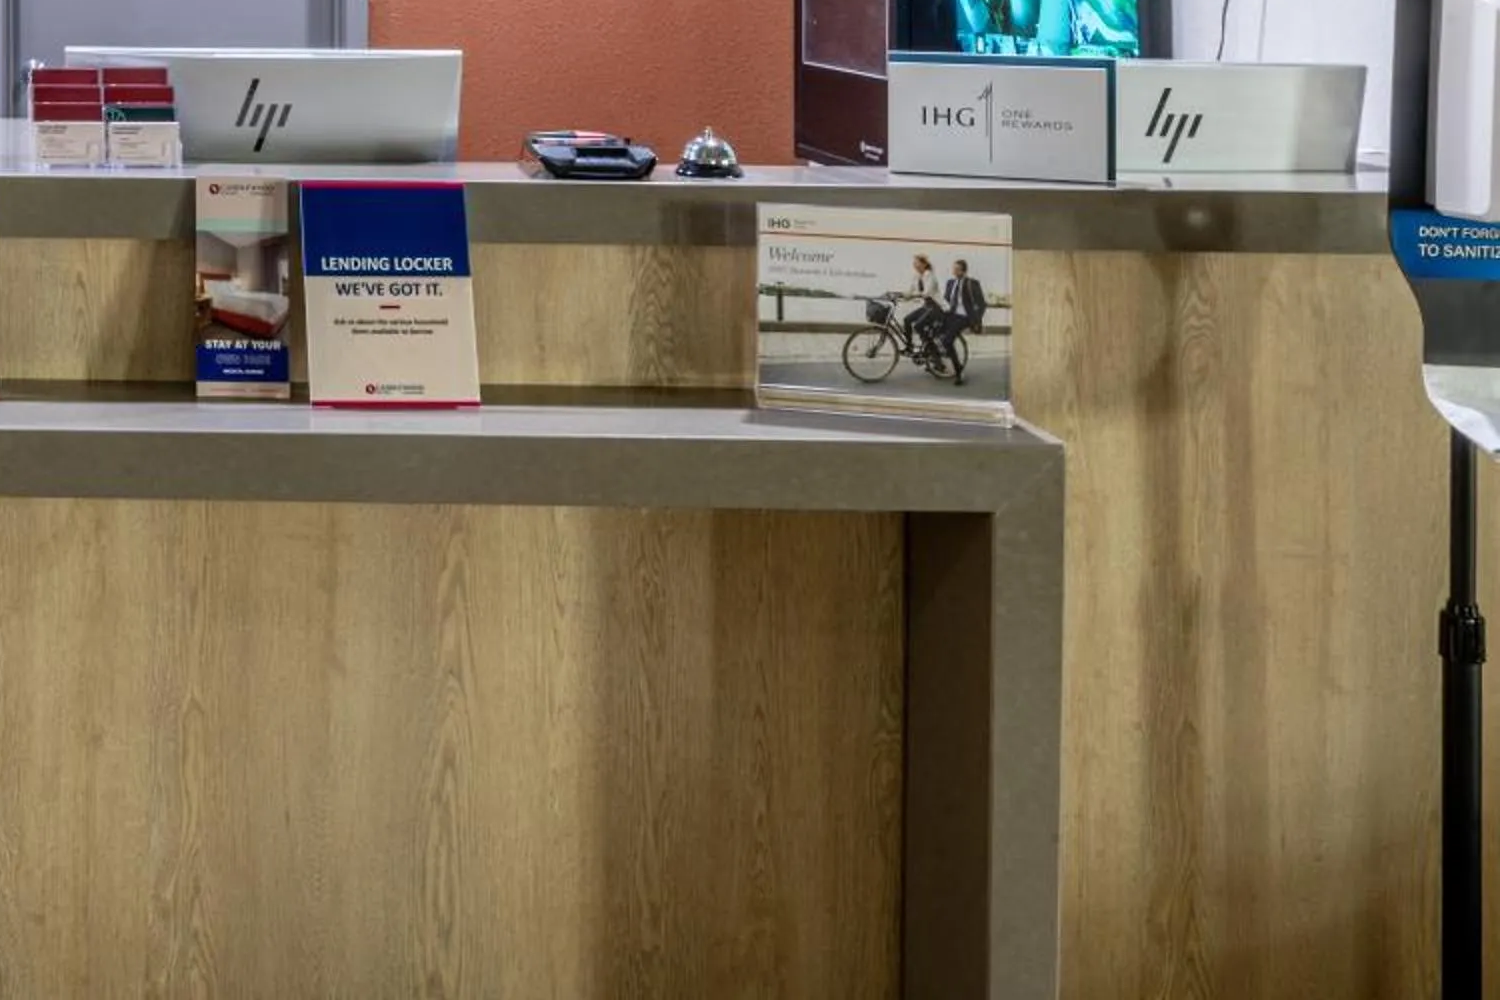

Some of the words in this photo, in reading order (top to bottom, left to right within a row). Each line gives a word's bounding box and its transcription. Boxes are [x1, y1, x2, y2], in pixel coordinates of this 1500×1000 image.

[921, 105, 975, 127] IHG
[1001, 109, 1032, 119] ONE
[1001, 119, 1073, 131] REWARDS
[767, 217, 791, 229] IHG
[1419, 225, 1460, 238] DON'T
[1417, 243, 1440, 257] TO
[321, 256, 390, 271] LENDING
[394, 257, 453, 271] LOCKER
[336, 282, 385, 296] WE'VE
[389, 283, 421, 296] GOT
[426, 283, 443, 296] IT.
[205, 339, 232, 350] STAY
